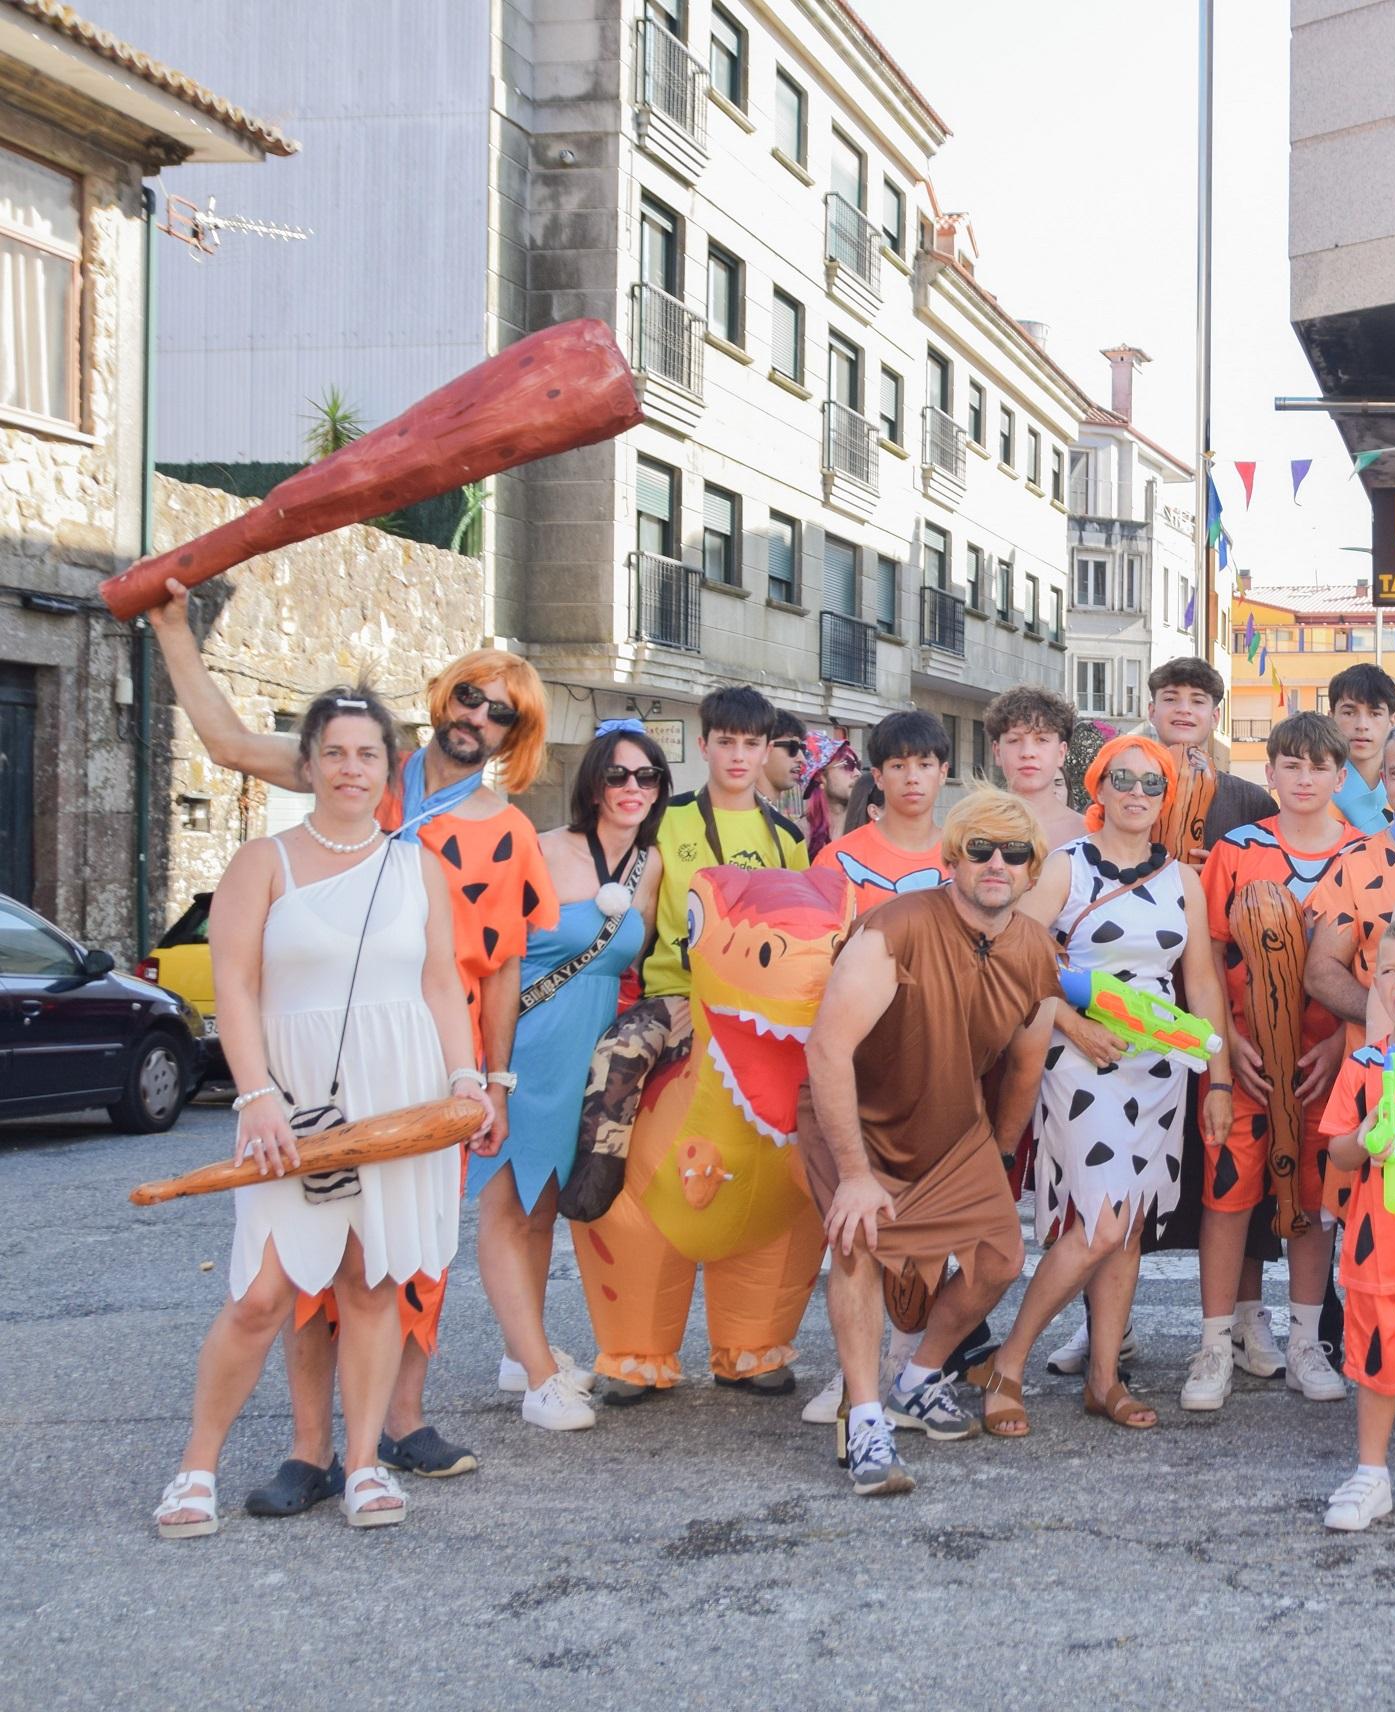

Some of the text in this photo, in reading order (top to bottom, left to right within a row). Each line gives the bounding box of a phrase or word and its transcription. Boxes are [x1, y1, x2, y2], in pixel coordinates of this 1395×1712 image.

[521, 973, 566, 1007] BIMBA
[560, 965, 572, 976] Y
[573, 939, 606, 969] LOLA
[633, 850, 647, 883] LOLA
